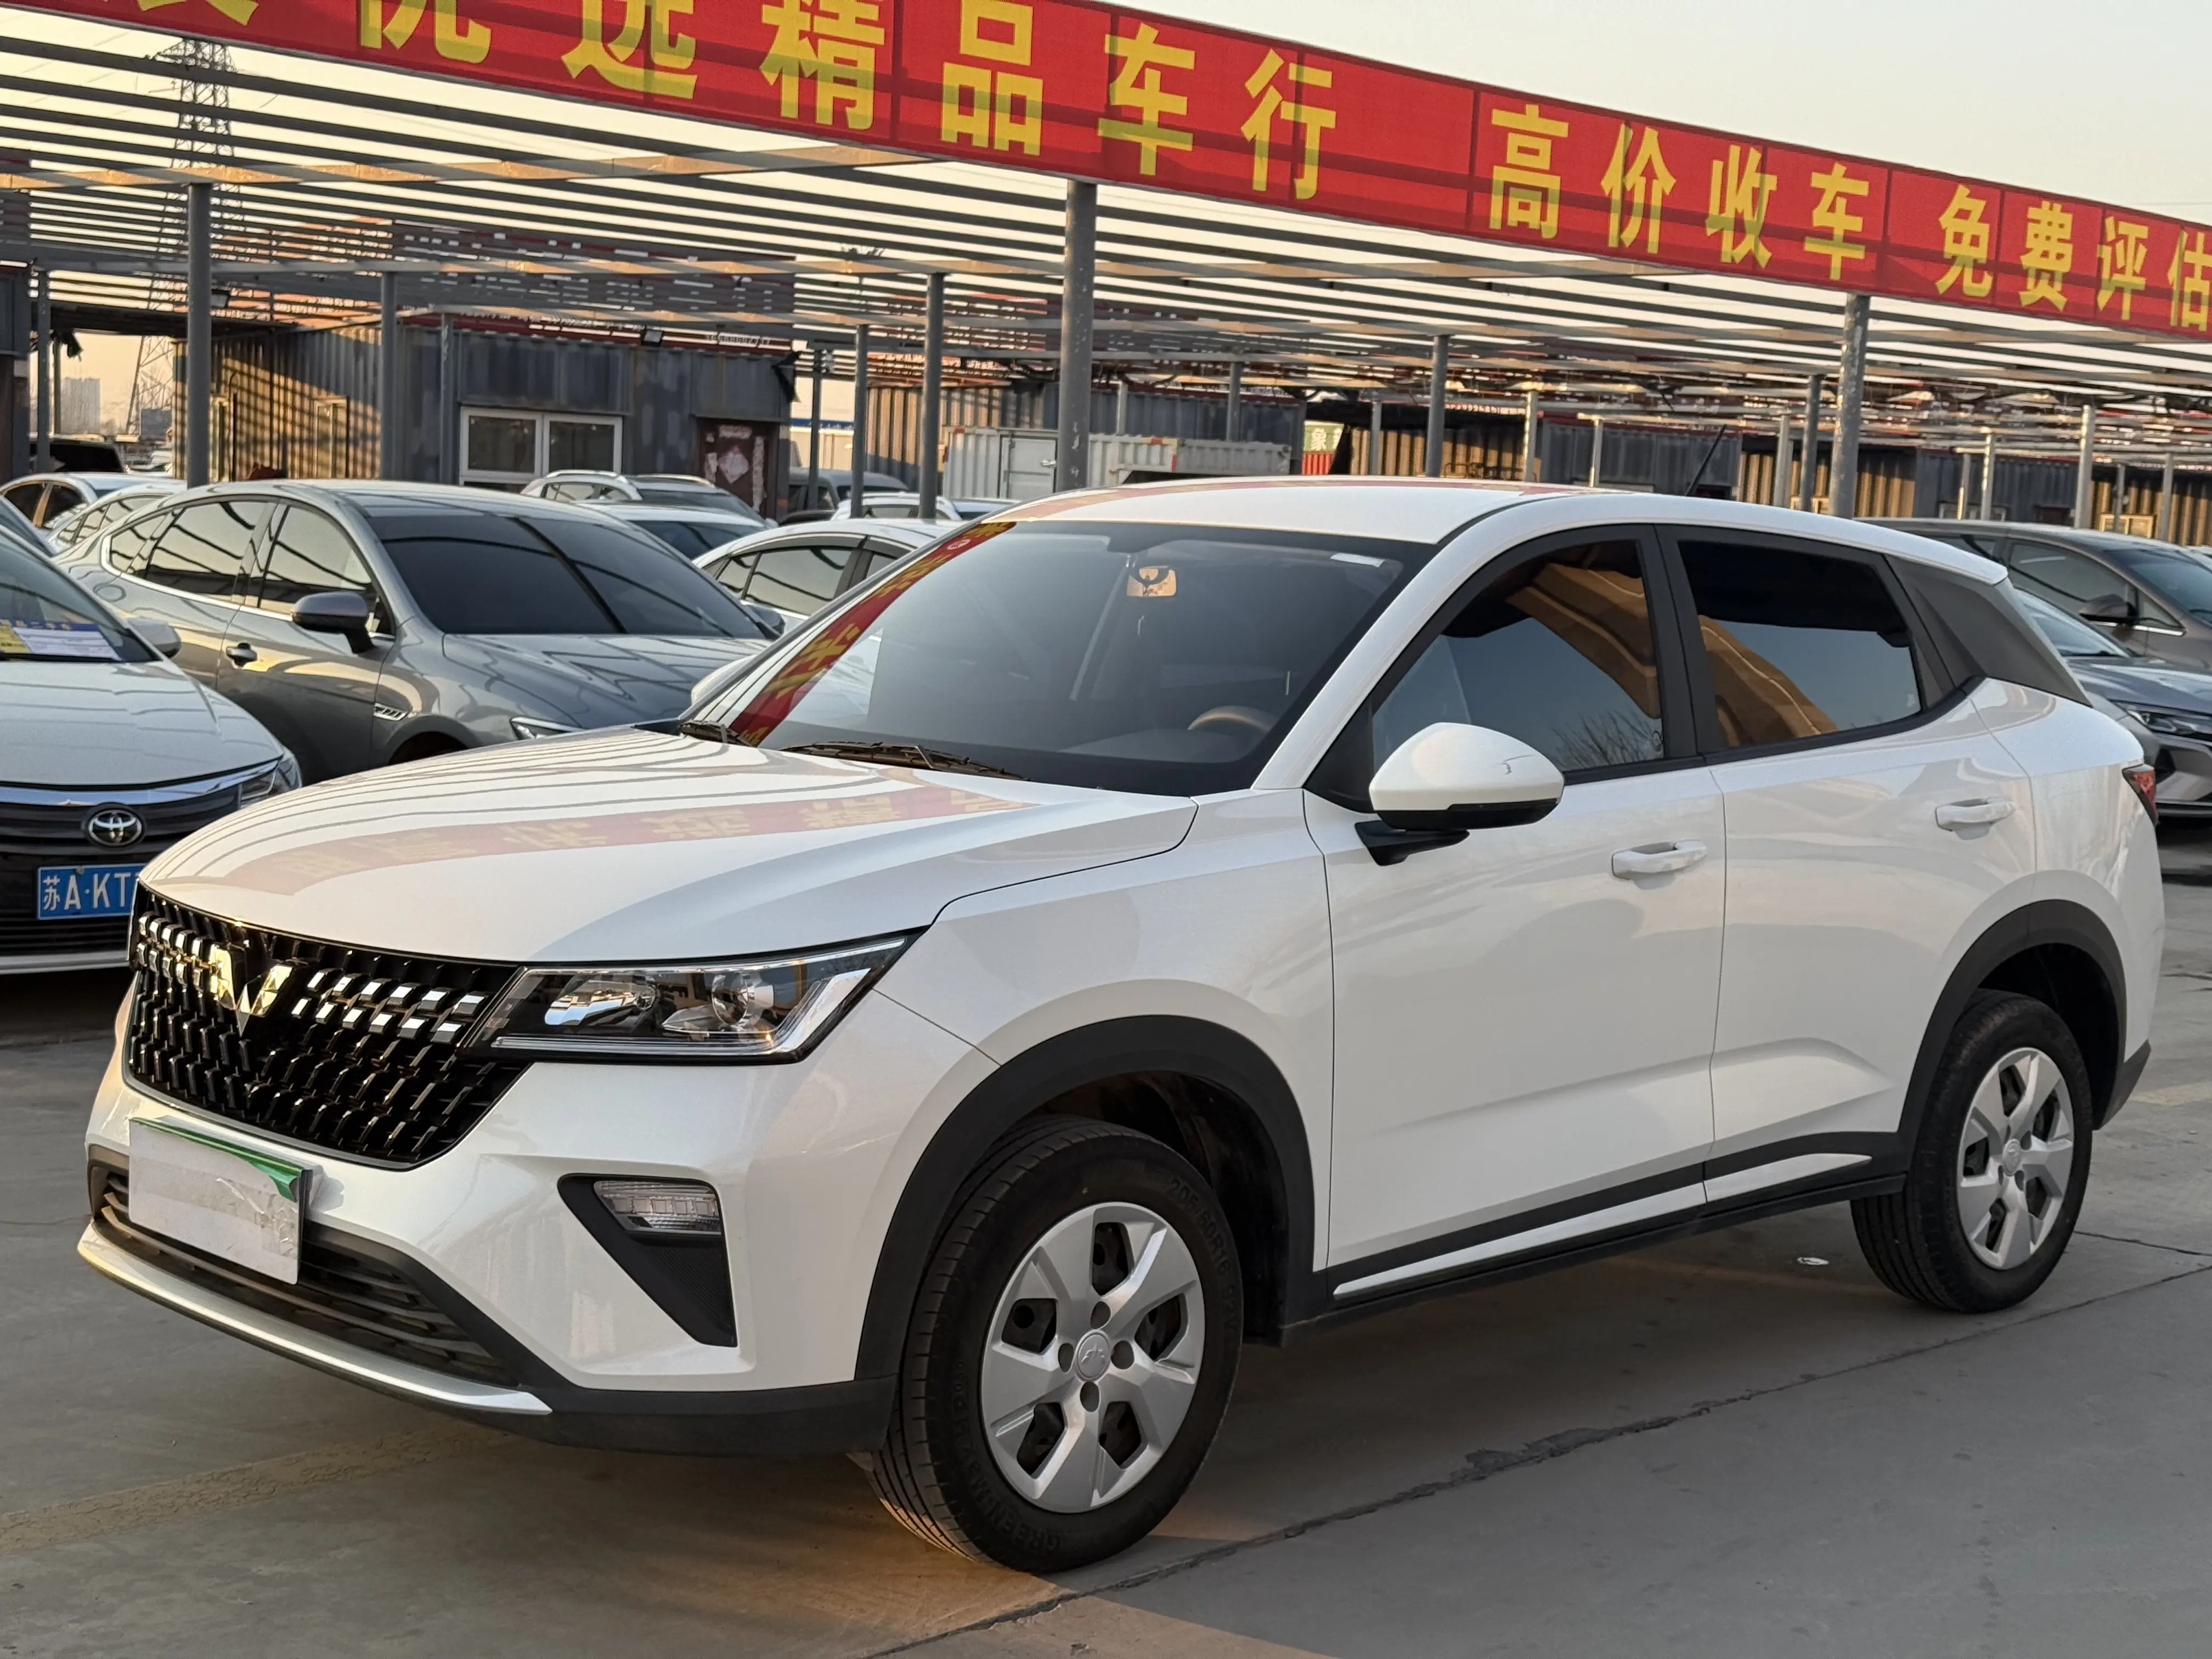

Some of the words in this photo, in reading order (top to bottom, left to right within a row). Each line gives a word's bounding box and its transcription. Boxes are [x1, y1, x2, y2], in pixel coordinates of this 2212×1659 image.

[139, 0, 1336, 199] 选精品车行
[1489, 104, 1869, 279] 高价收车
[1936, 185, 2212, 330] 免费评估
[43, 872, 138, 911] 苏A·KT
